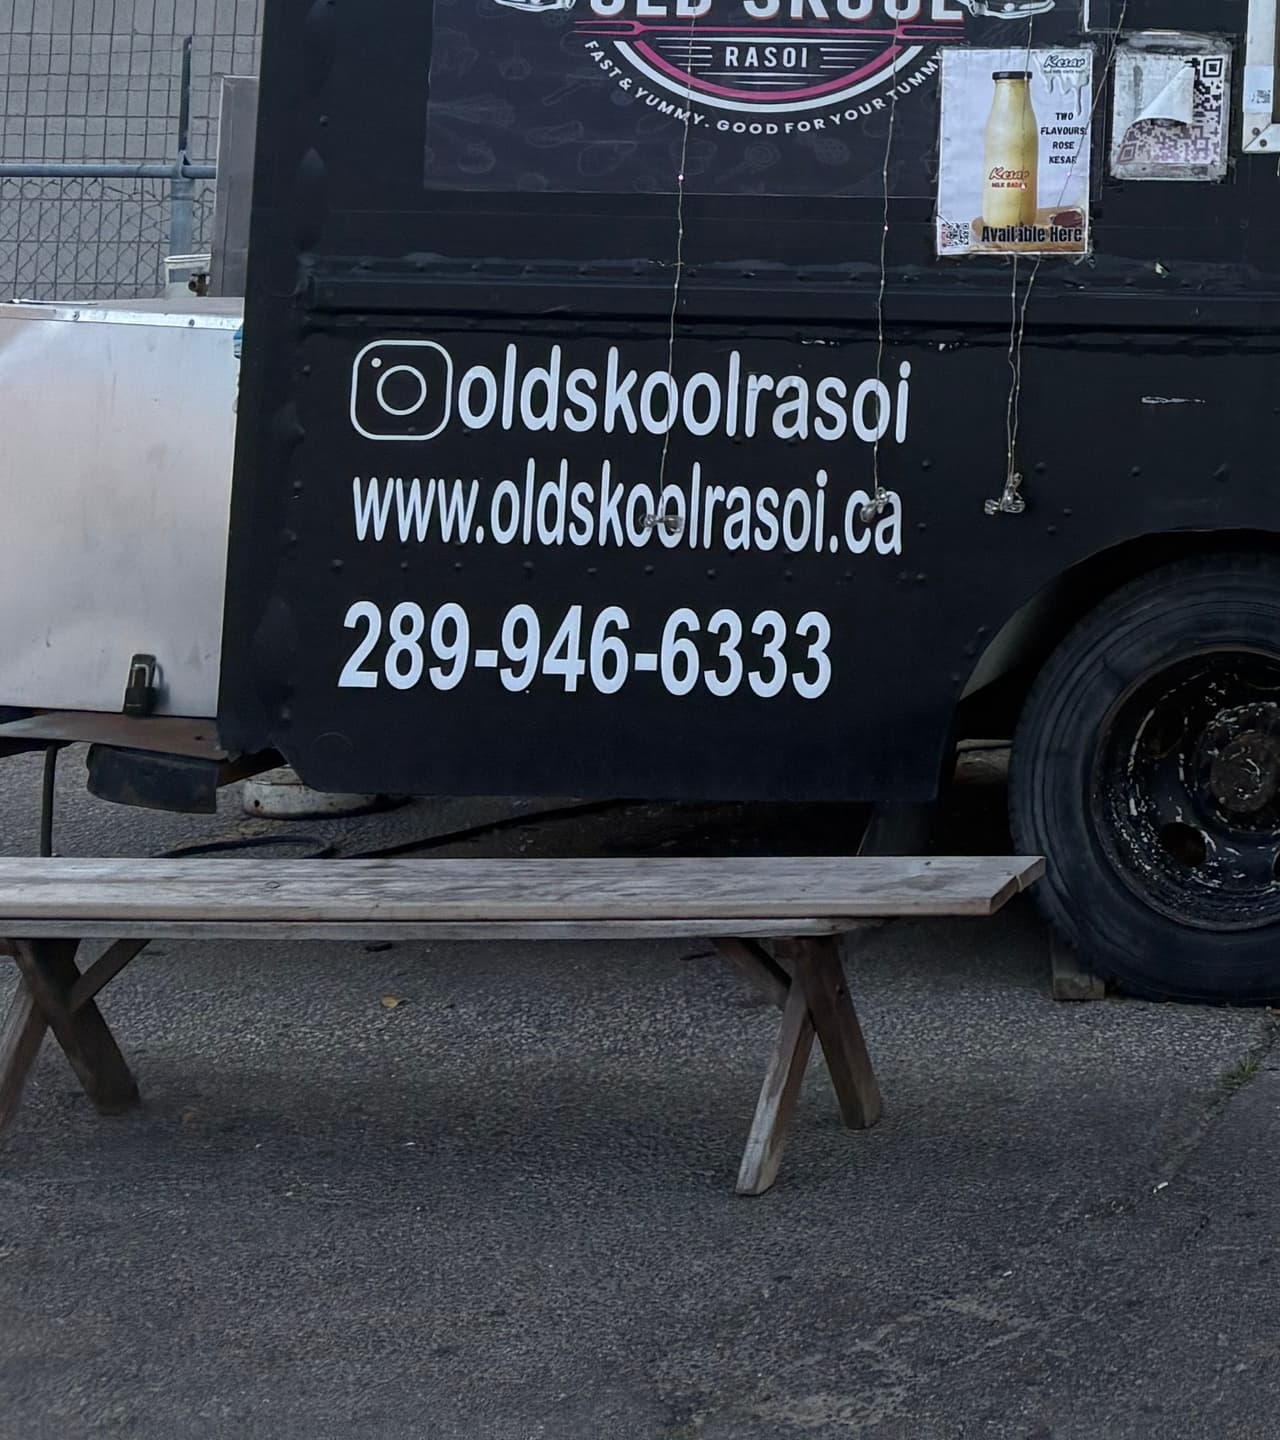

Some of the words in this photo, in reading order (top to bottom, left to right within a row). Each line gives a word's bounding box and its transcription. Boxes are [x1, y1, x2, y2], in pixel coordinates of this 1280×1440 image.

[725, 46, 807, 68] RASOI
[1043, 55, 1085, 69] Kesar
[585, 40, 622, 79] FAST
[619, 77, 632, 89] &
[717, 120, 778, 135] GOOD
[785, 119, 826, 134] FOR
[830, 98, 886, 125] YOUR
[883, 51, 943, 101] TUMMY
[1052, 142, 1074, 150] ROSE
[1049, 156, 1076, 164] KESAR
[982, 225, 1045, 243] Available
[1050, 226, 1082, 243] Here
[457, 343, 912, 443] oldskoolrasoi
[353, 458, 902, 556] www.oldskoolrasoi.ca
[338, 601, 832, 700] 289-946-6333
